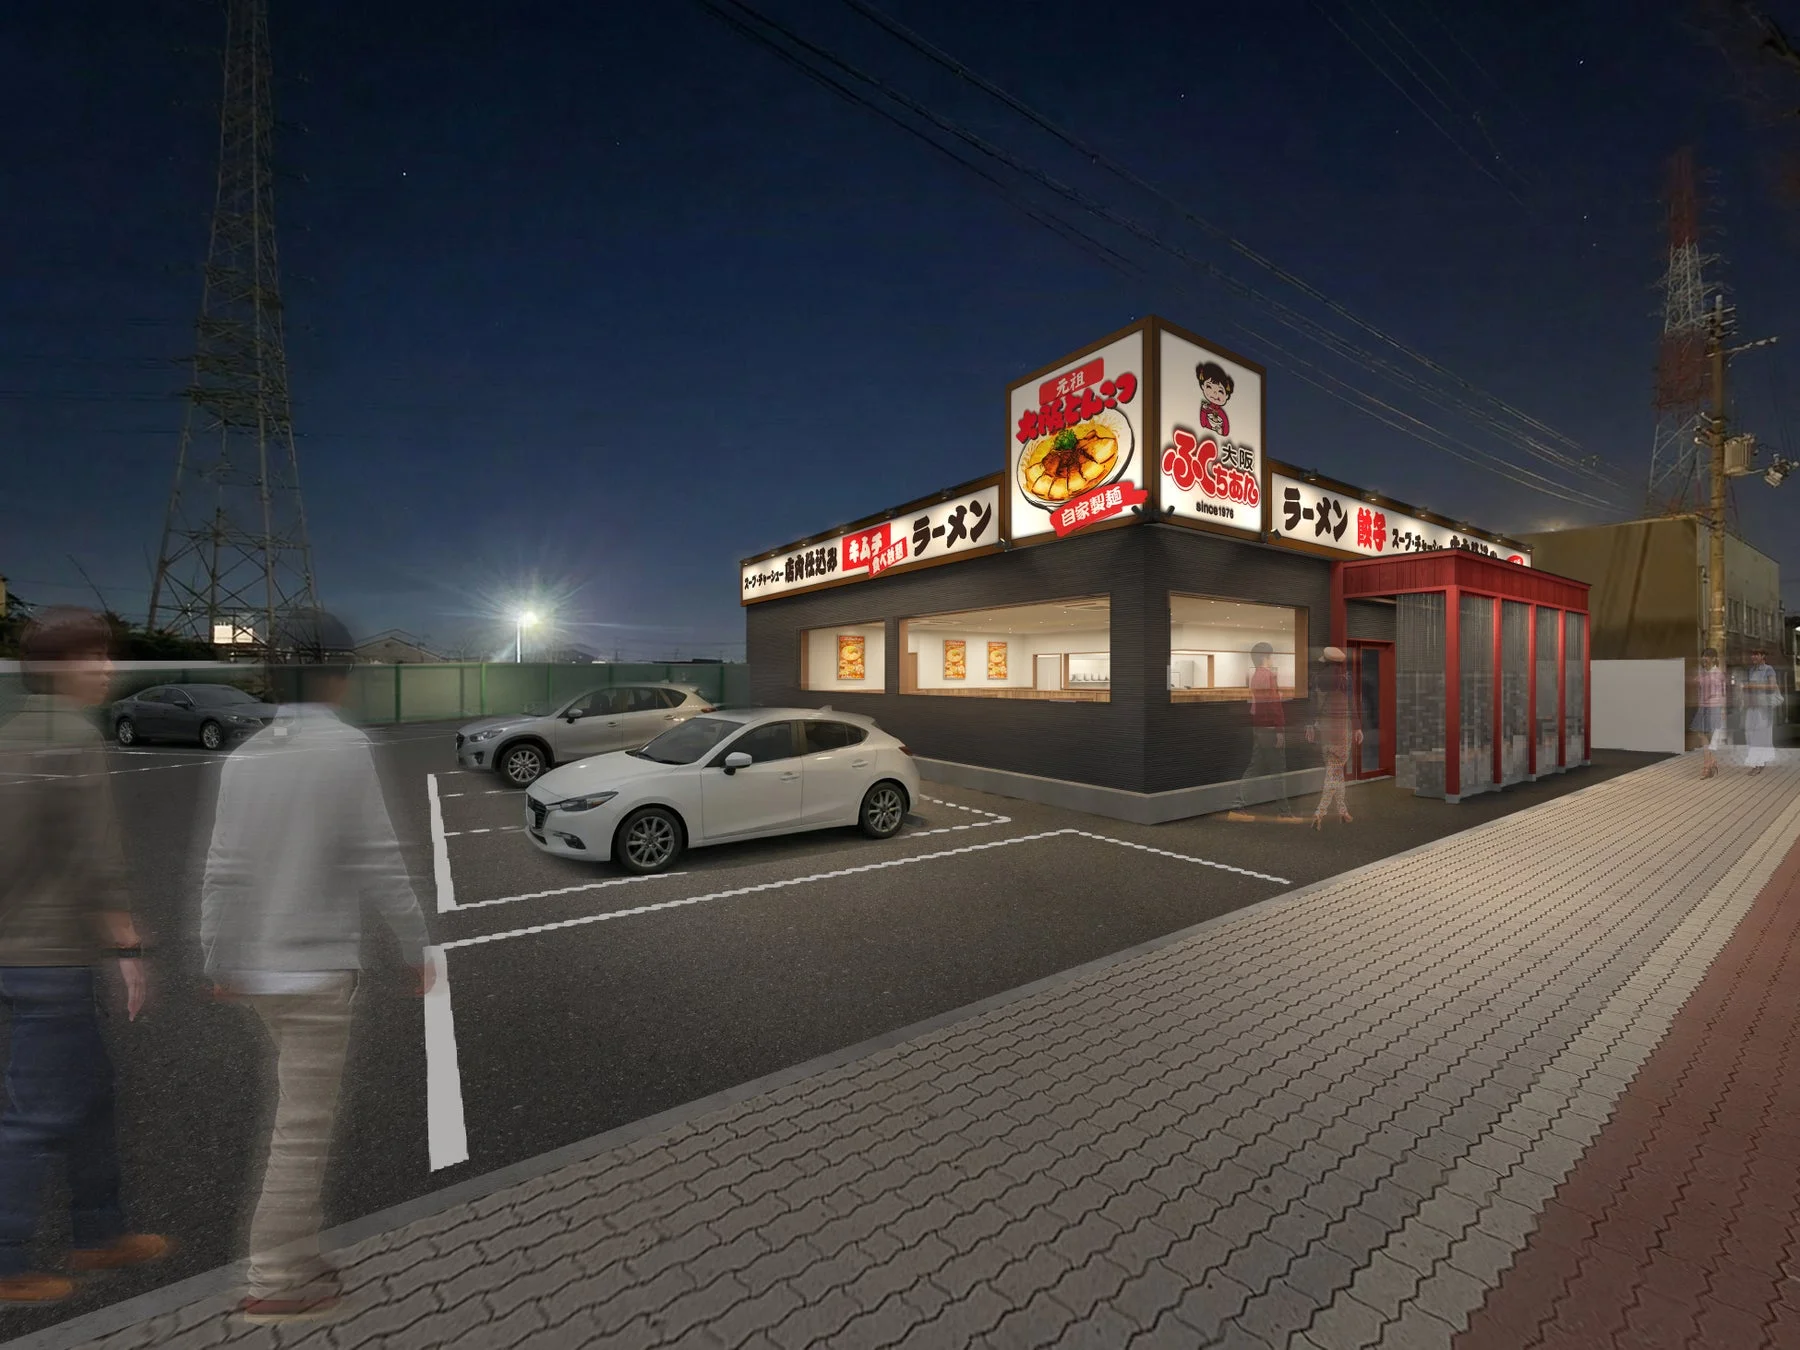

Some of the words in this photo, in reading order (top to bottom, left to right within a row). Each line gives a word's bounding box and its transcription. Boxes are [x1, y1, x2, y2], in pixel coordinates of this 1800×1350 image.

[1056, 371, 1085, 397] 元祖
[1016, 372, 1138, 444] 大阪とんこつ
[1221, 444, 1254, 472] 大阪
[1061, 486, 1123, 527] 自家製麺
[1283, 487, 1348, 542] ラーメン
[849, 531, 882, 563] キムチ
[912, 500, 991, 556] ラーメン
[1357, 507, 1386, 552] 餃子
[785, 547, 837, 583] 店内仕込み
